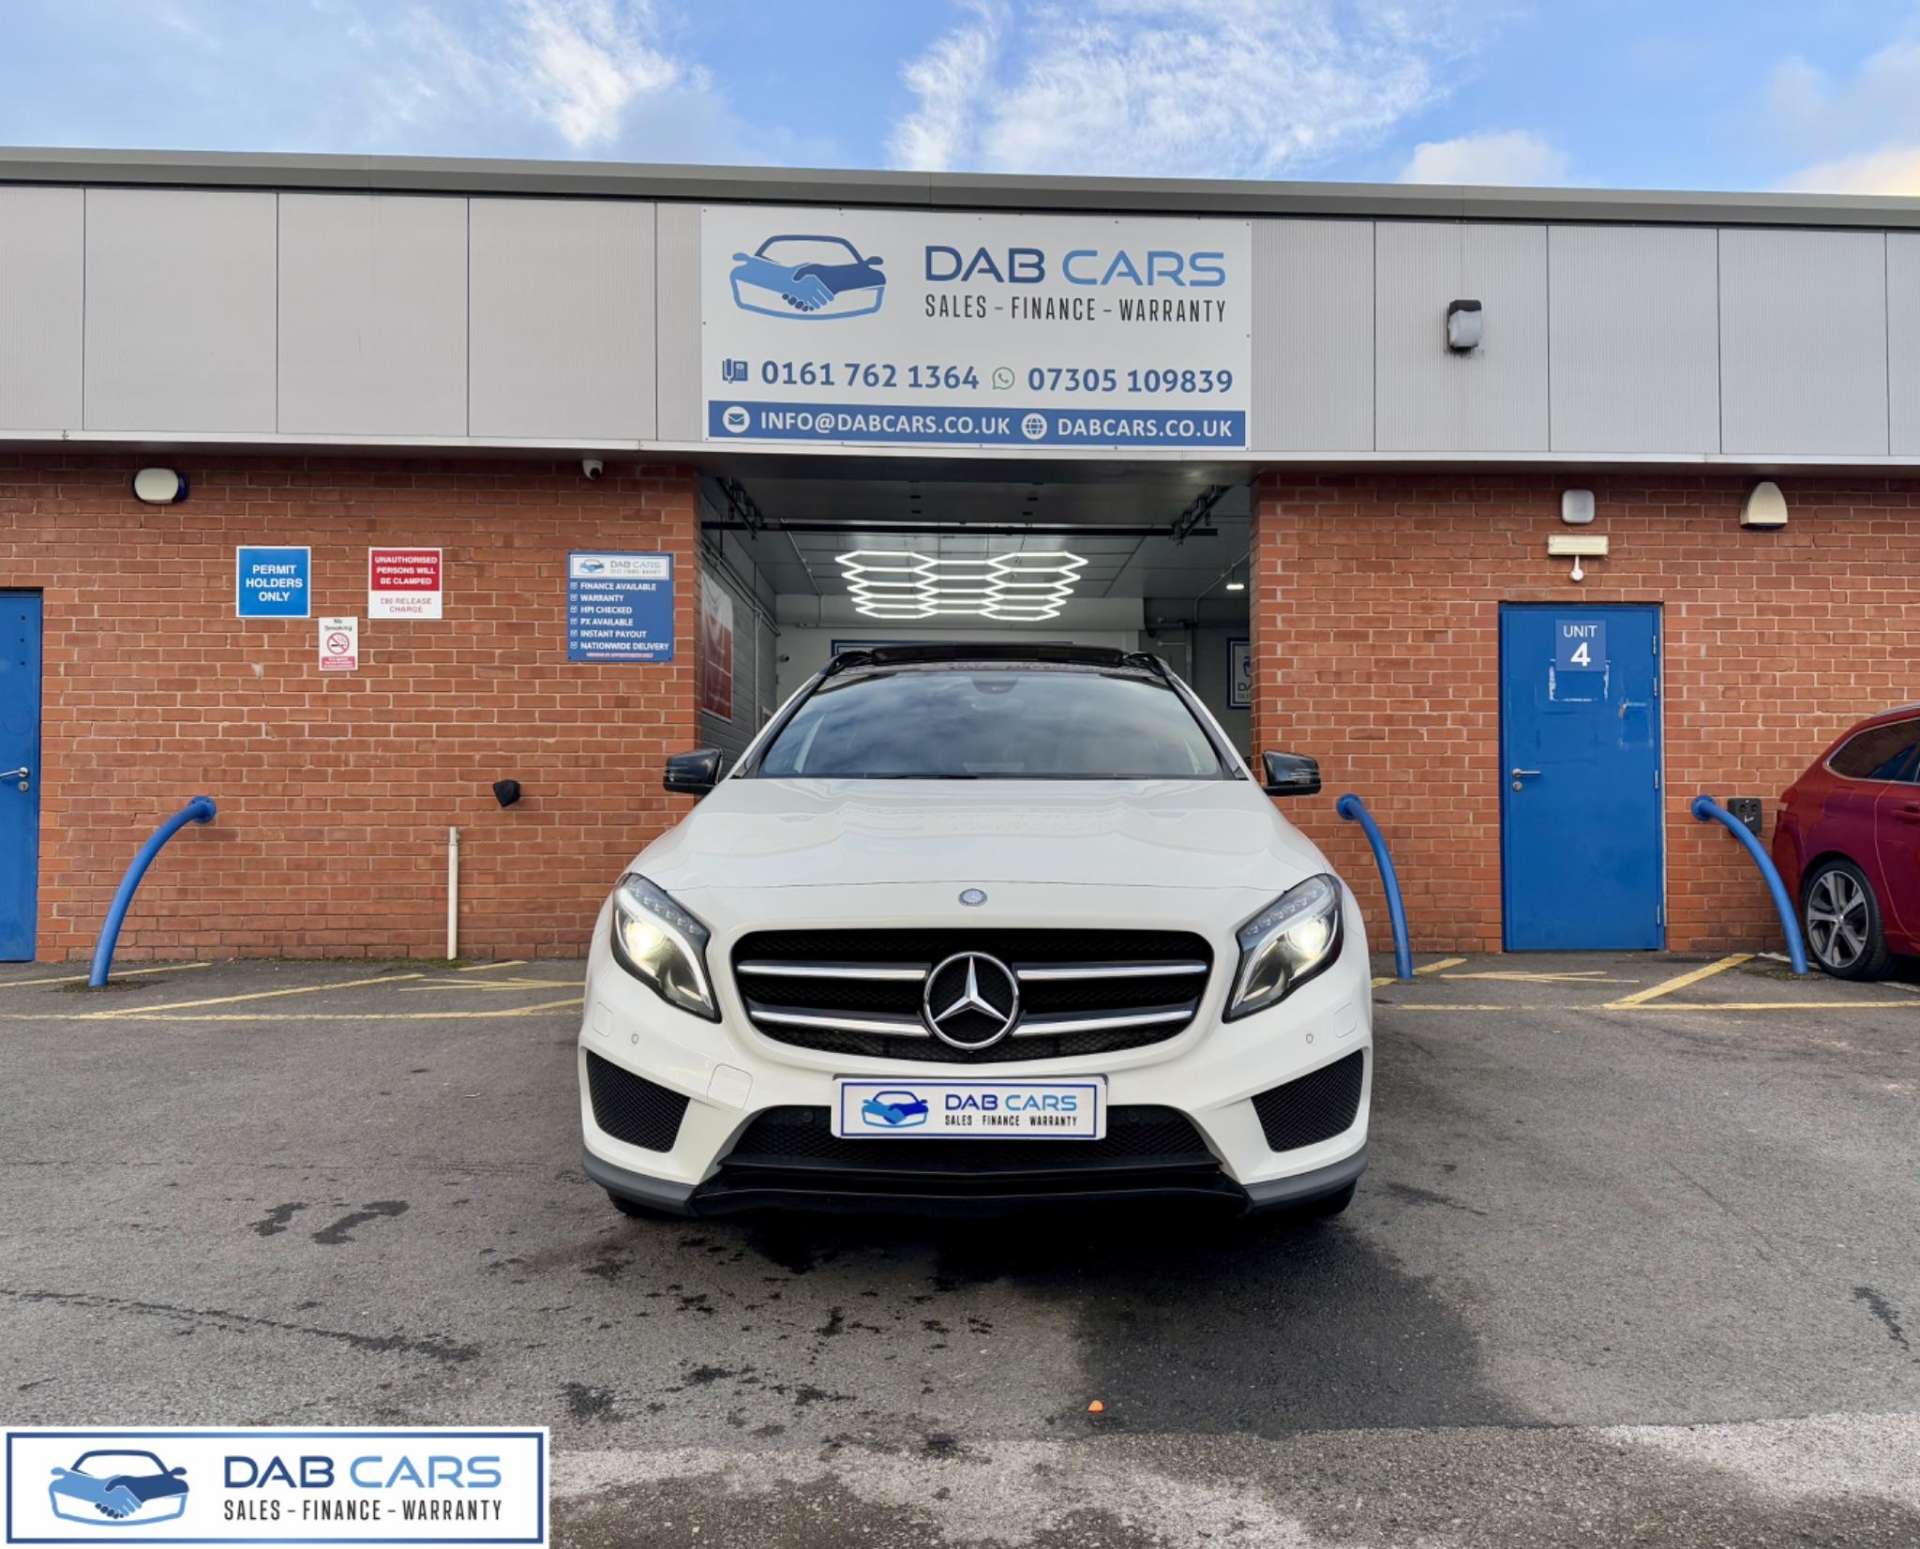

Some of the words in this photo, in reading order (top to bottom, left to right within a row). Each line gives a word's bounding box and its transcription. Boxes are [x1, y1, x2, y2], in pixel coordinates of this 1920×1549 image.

[924, 245, 1045, 284] DAB
[1062, 249, 1226, 287] CARS
[924, 294, 987, 319] SALES
[1011, 296, 1096, 321] FINANCE
[1118, 298, 1226, 323] WARRANTY
[761, 360, 835, 387] 0161
[845, 363, 897, 388] 762
[907, 365, 979, 390] 1364
[1027, 367, 1117, 393] 07305
[1127, 369, 1233, 394] 109839
[761, 411, 1011, 436] INFO@DABCARS.CO.UK
[1057, 416, 1233, 438] DABCARS.CO.UK
[374, 556, 438, 564] UNAUTHORISED
[252, 564, 297, 575] PERMIT
[376, 566, 415, 574] PERSONS
[416, 567, 436, 575] WILL
[245, 578, 303, 588] HOLDERS
[380, 577, 392, 585] BE
[393, 577, 433, 585] CLAMPED
[580, 582, 614, 590] FINANCE
[615, 583, 657, 591] AVAILABLE
[258, 591, 290, 602] ONLY
[394, 597, 432, 605] RELEASE
[580, 594, 624, 602] WARRANTY
[389, 605, 424, 613] CHARGE
[596, 606, 633, 614] CHECKED
[592, 618, 634, 626] AVAILABLE
[580, 629, 614, 638] INSTANT
[615, 630, 648, 638] PAYOUT
[1563, 625, 1598, 638] UNIT
[580, 642, 631, 650] NATIONWIDE
[632, 643, 670, 651] DELIVERY
[1570, 641, 1592, 667] 4
[944, 1094, 998, 1111] DAB
[1004, 1094, 1077, 1111] CARS
[944, 1115, 973, 1126] SALES
[982, 1115, 1020, 1126] FINANCE
[1029, 1115, 1078, 1127] WARRANTY
